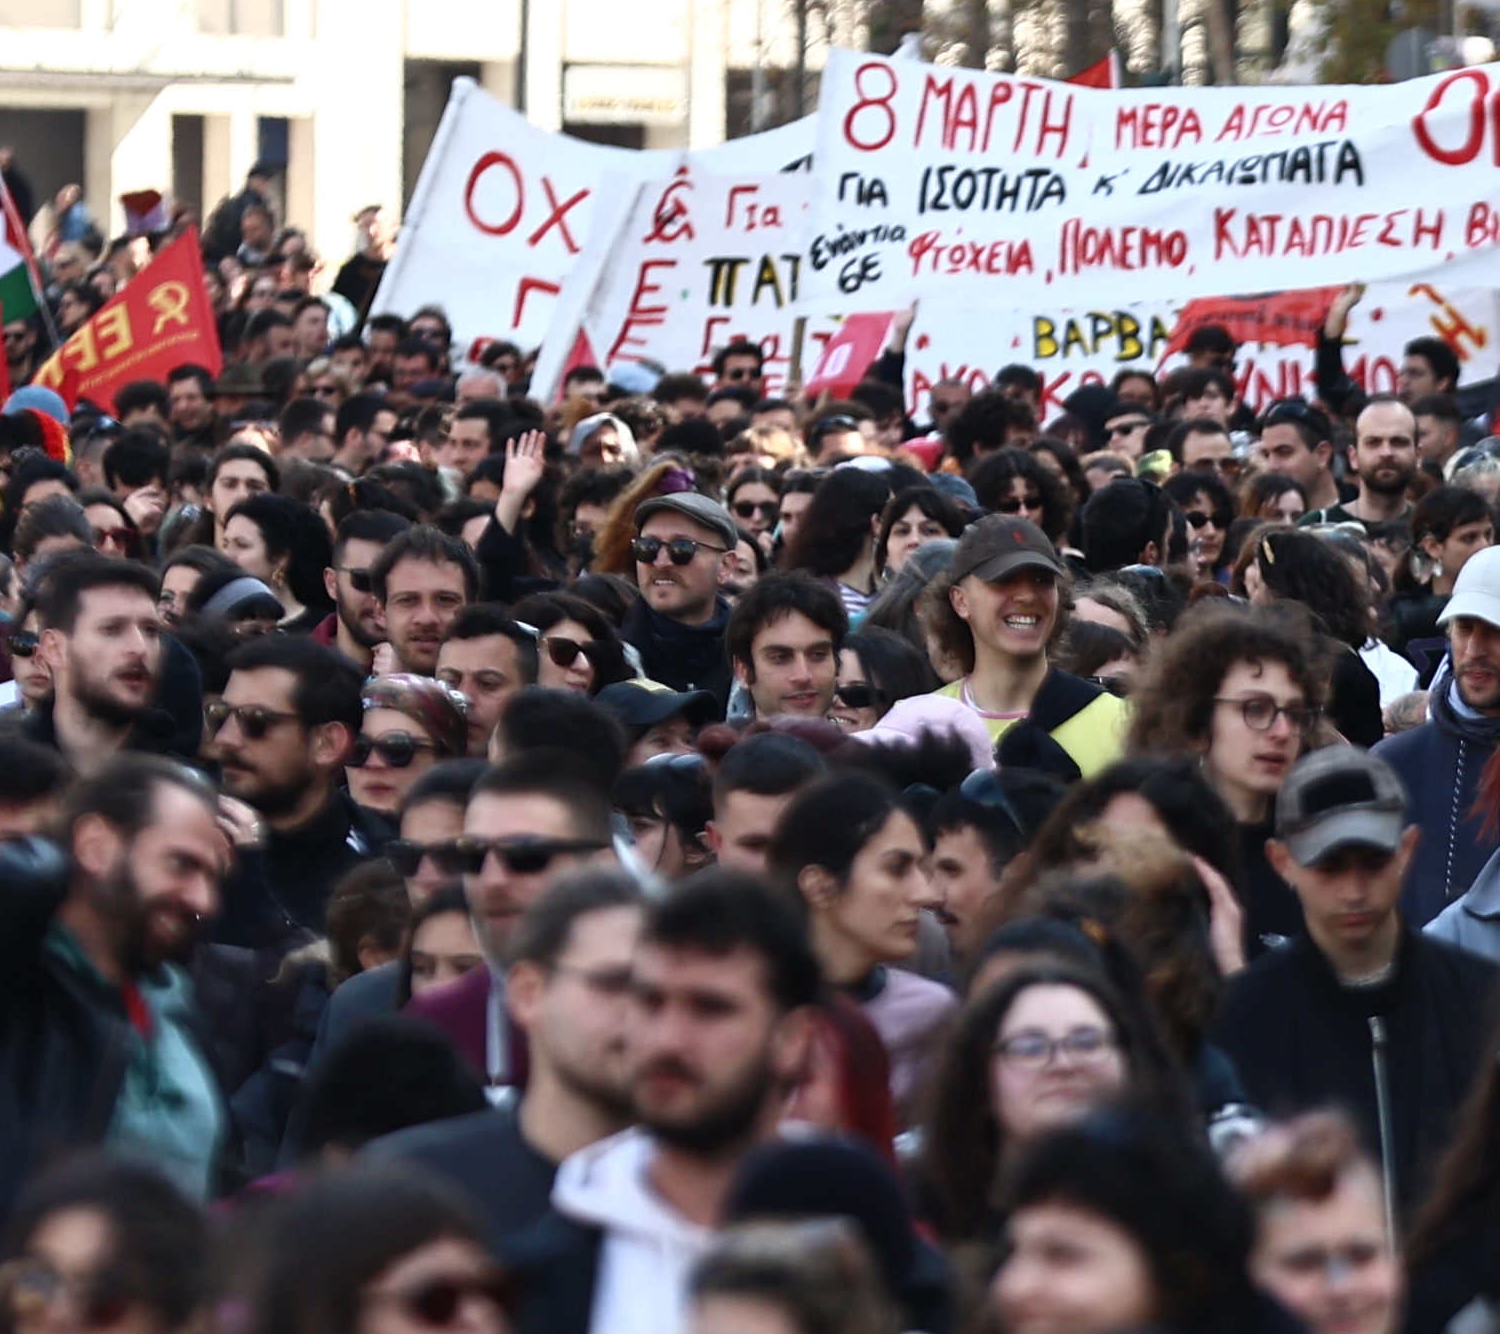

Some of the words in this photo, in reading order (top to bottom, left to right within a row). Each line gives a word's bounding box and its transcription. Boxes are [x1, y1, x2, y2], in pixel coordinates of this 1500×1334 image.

[843, 61, 898, 152] 8
[1115, 102, 1203, 150] ΜΕΡΑ
[837, 170, 889, 209] ΓΙΑ
[918, 164, 1068, 215] ΙΣΟΤΗΤΑ
[1137, 138, 1365, 196] ΔΙΚΑΙΩΜΑΤΑ
